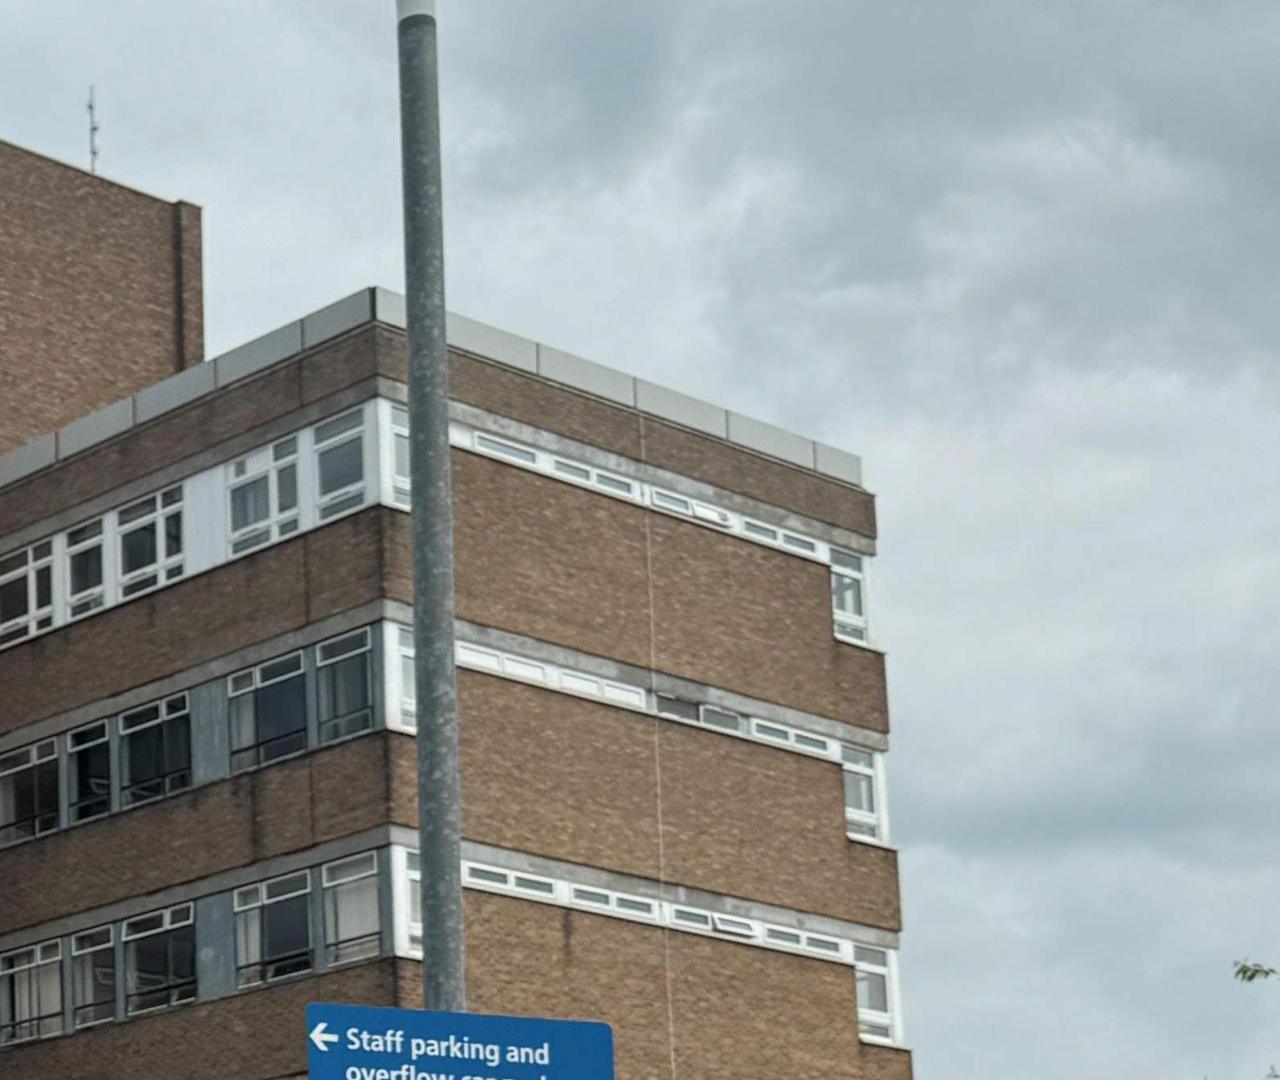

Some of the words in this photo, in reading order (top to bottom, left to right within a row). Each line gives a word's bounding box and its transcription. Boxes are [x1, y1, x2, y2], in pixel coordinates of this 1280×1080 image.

[346, 1027, 404, 1054] Staff
[410, 1035, 500, 1067] parking
[505, 1042, 550, 1065] and
